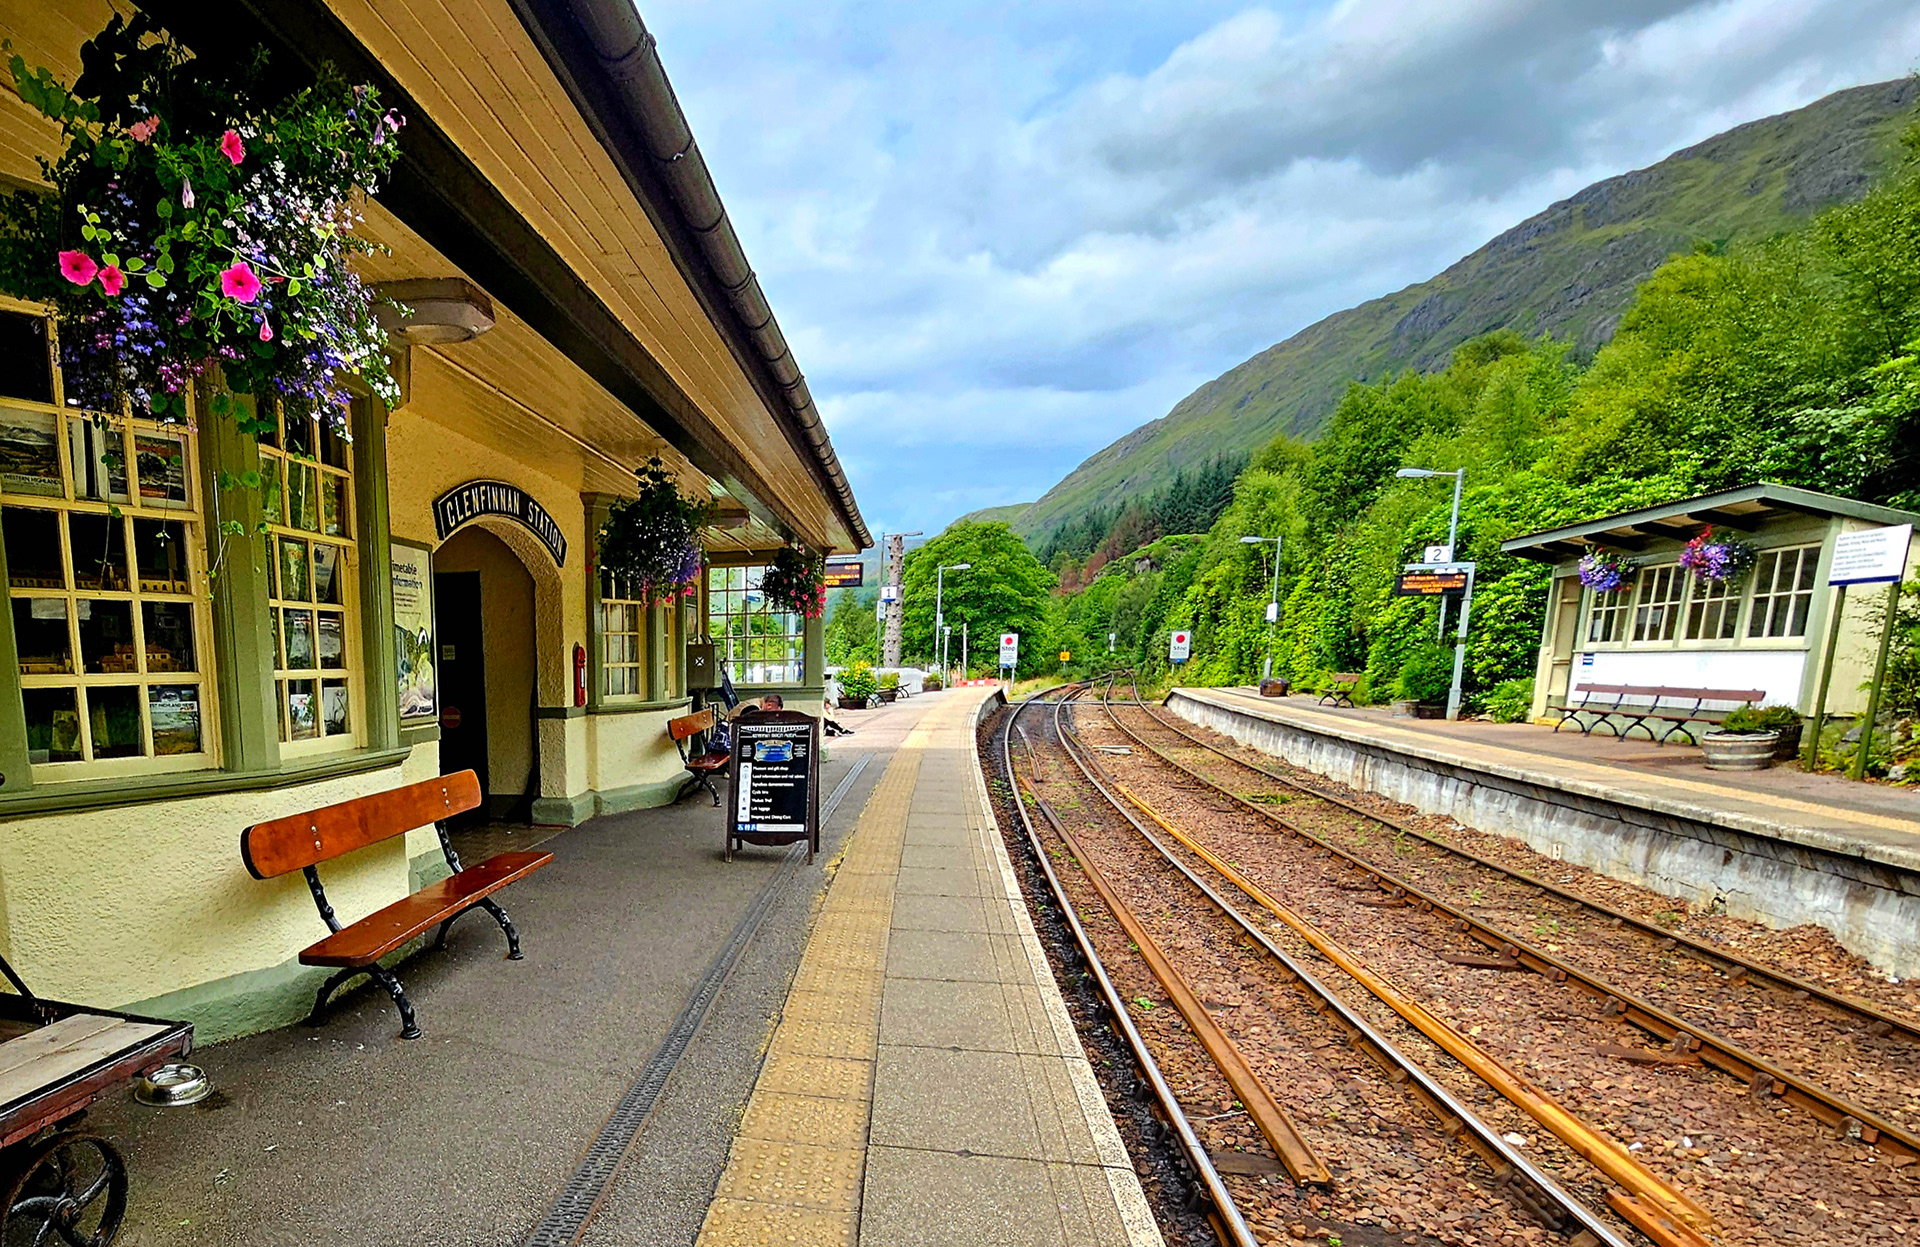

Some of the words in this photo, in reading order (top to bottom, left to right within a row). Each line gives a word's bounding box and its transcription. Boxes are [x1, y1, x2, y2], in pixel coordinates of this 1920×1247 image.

[446, 485, 520, 528] GLENFINNAN
[527, 501, 564, 557] STATION
[1432, 548, 1442, 562] 2
[392, 559, 417, 575] imetable
[393, 574, 423, 590] nformation
[886, 588, 891, 598] 1
